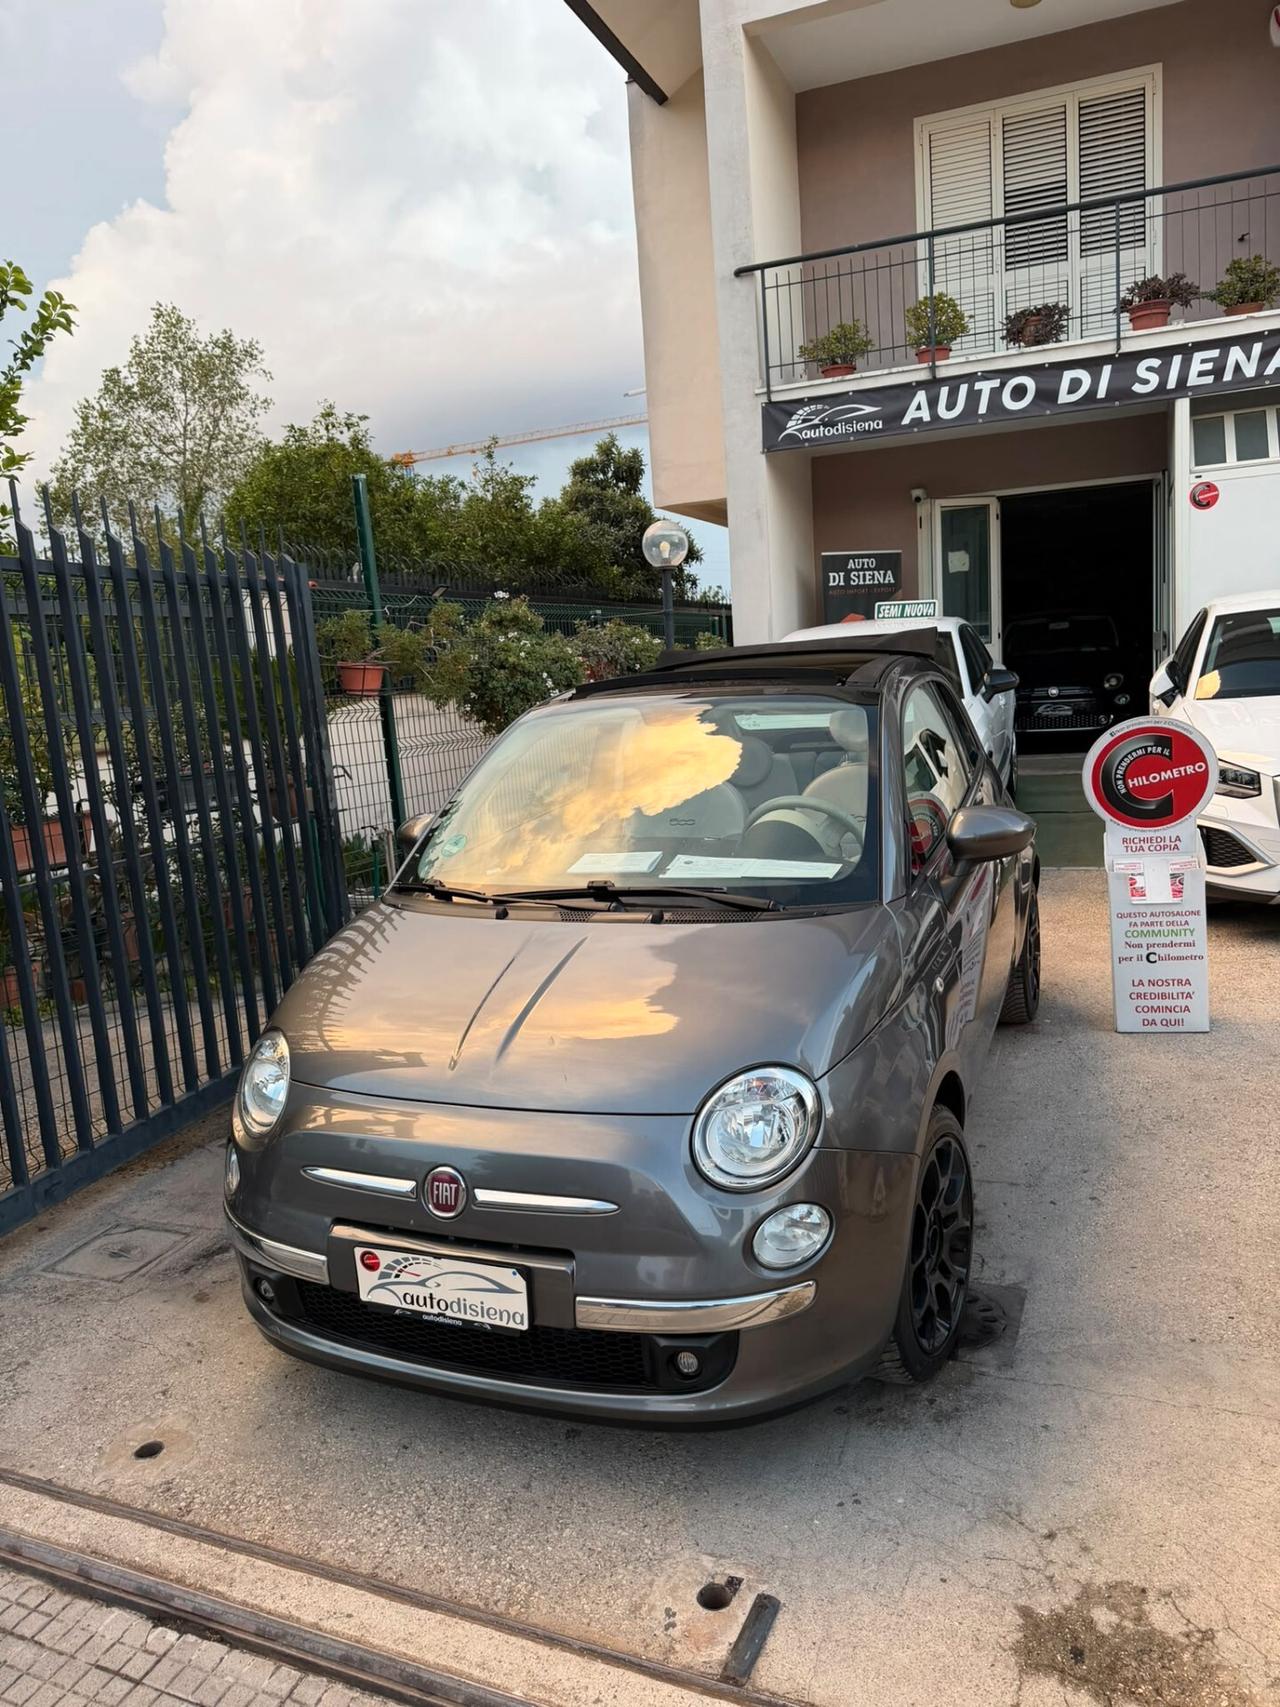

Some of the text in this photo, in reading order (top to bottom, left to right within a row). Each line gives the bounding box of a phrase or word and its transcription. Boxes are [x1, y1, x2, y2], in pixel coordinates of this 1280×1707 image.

[901, 375, 1036, 425] AUTO
[1057, 364, 1112, 404] DI
[801, 419, 883, 439] autodisiena
[847, 558, 876, 569] AUTO
[828, 570, 895, 586] DI SIENA
[879, 603, 935, 617] SEMI NUOVA
[1116, 746, 1170, 794] NON PRENDERMI PER IL
[1122, 835, 1181, 845] RICHIEDI LA
[1124, 843, 1180, 853] TUA COPIA
[1116, 910, 1201, 919] QUESTO AUTOSALONE
[1124, 928, 1195, 938] COMMUNITY
[1124, 940, 1196, 950] Non prendermi
[1118, 952, 1204, 964] per il Chilometro
[1132, 978, 1192, 987] LA NOSTRA
[1135, 1005, 1191, 1013] COMINCIA
[1142, 1018, 1185, 1028] DA QUI!
[433, 1181, 457, 1206] FIAT
[403, 1291, 525, 1327] autodisiena
[422, 1313, 463, 1327] autodisiena
